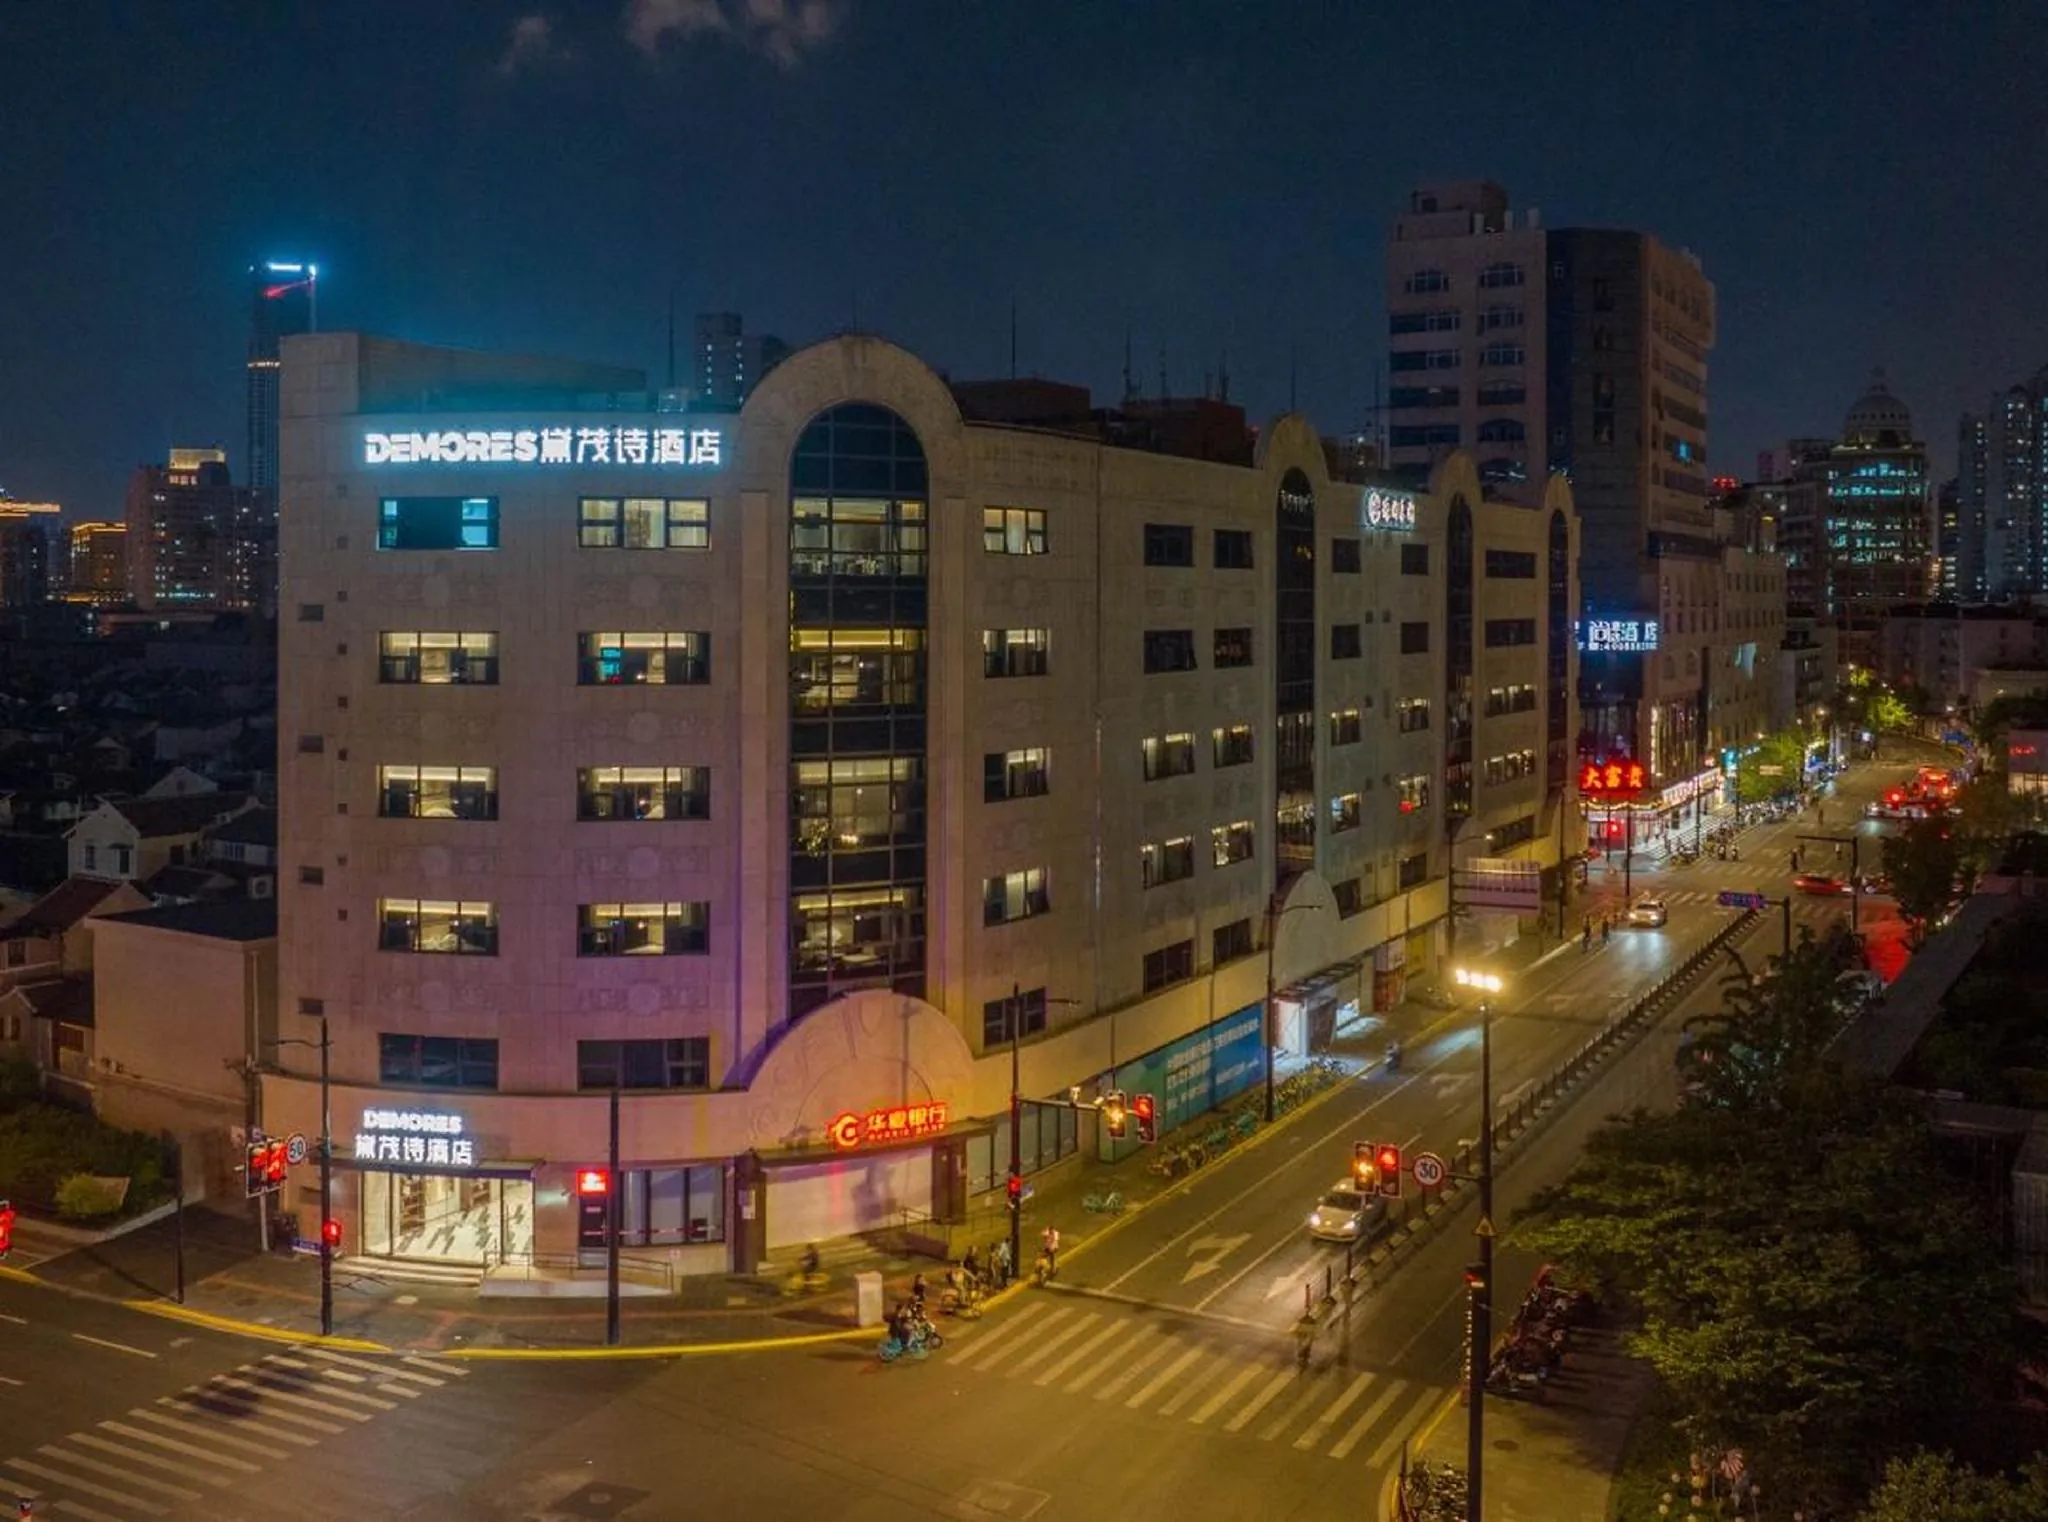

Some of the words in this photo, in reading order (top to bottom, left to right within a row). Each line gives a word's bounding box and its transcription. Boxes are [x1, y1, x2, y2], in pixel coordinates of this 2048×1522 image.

[365, 431, 537, 463] DEMORES
[540, 427, 720, 465] 黛茂诗酒店
[363, 1109, 462, 1134] DEMORES
[1420, 1162, 1438, 1180] 30
